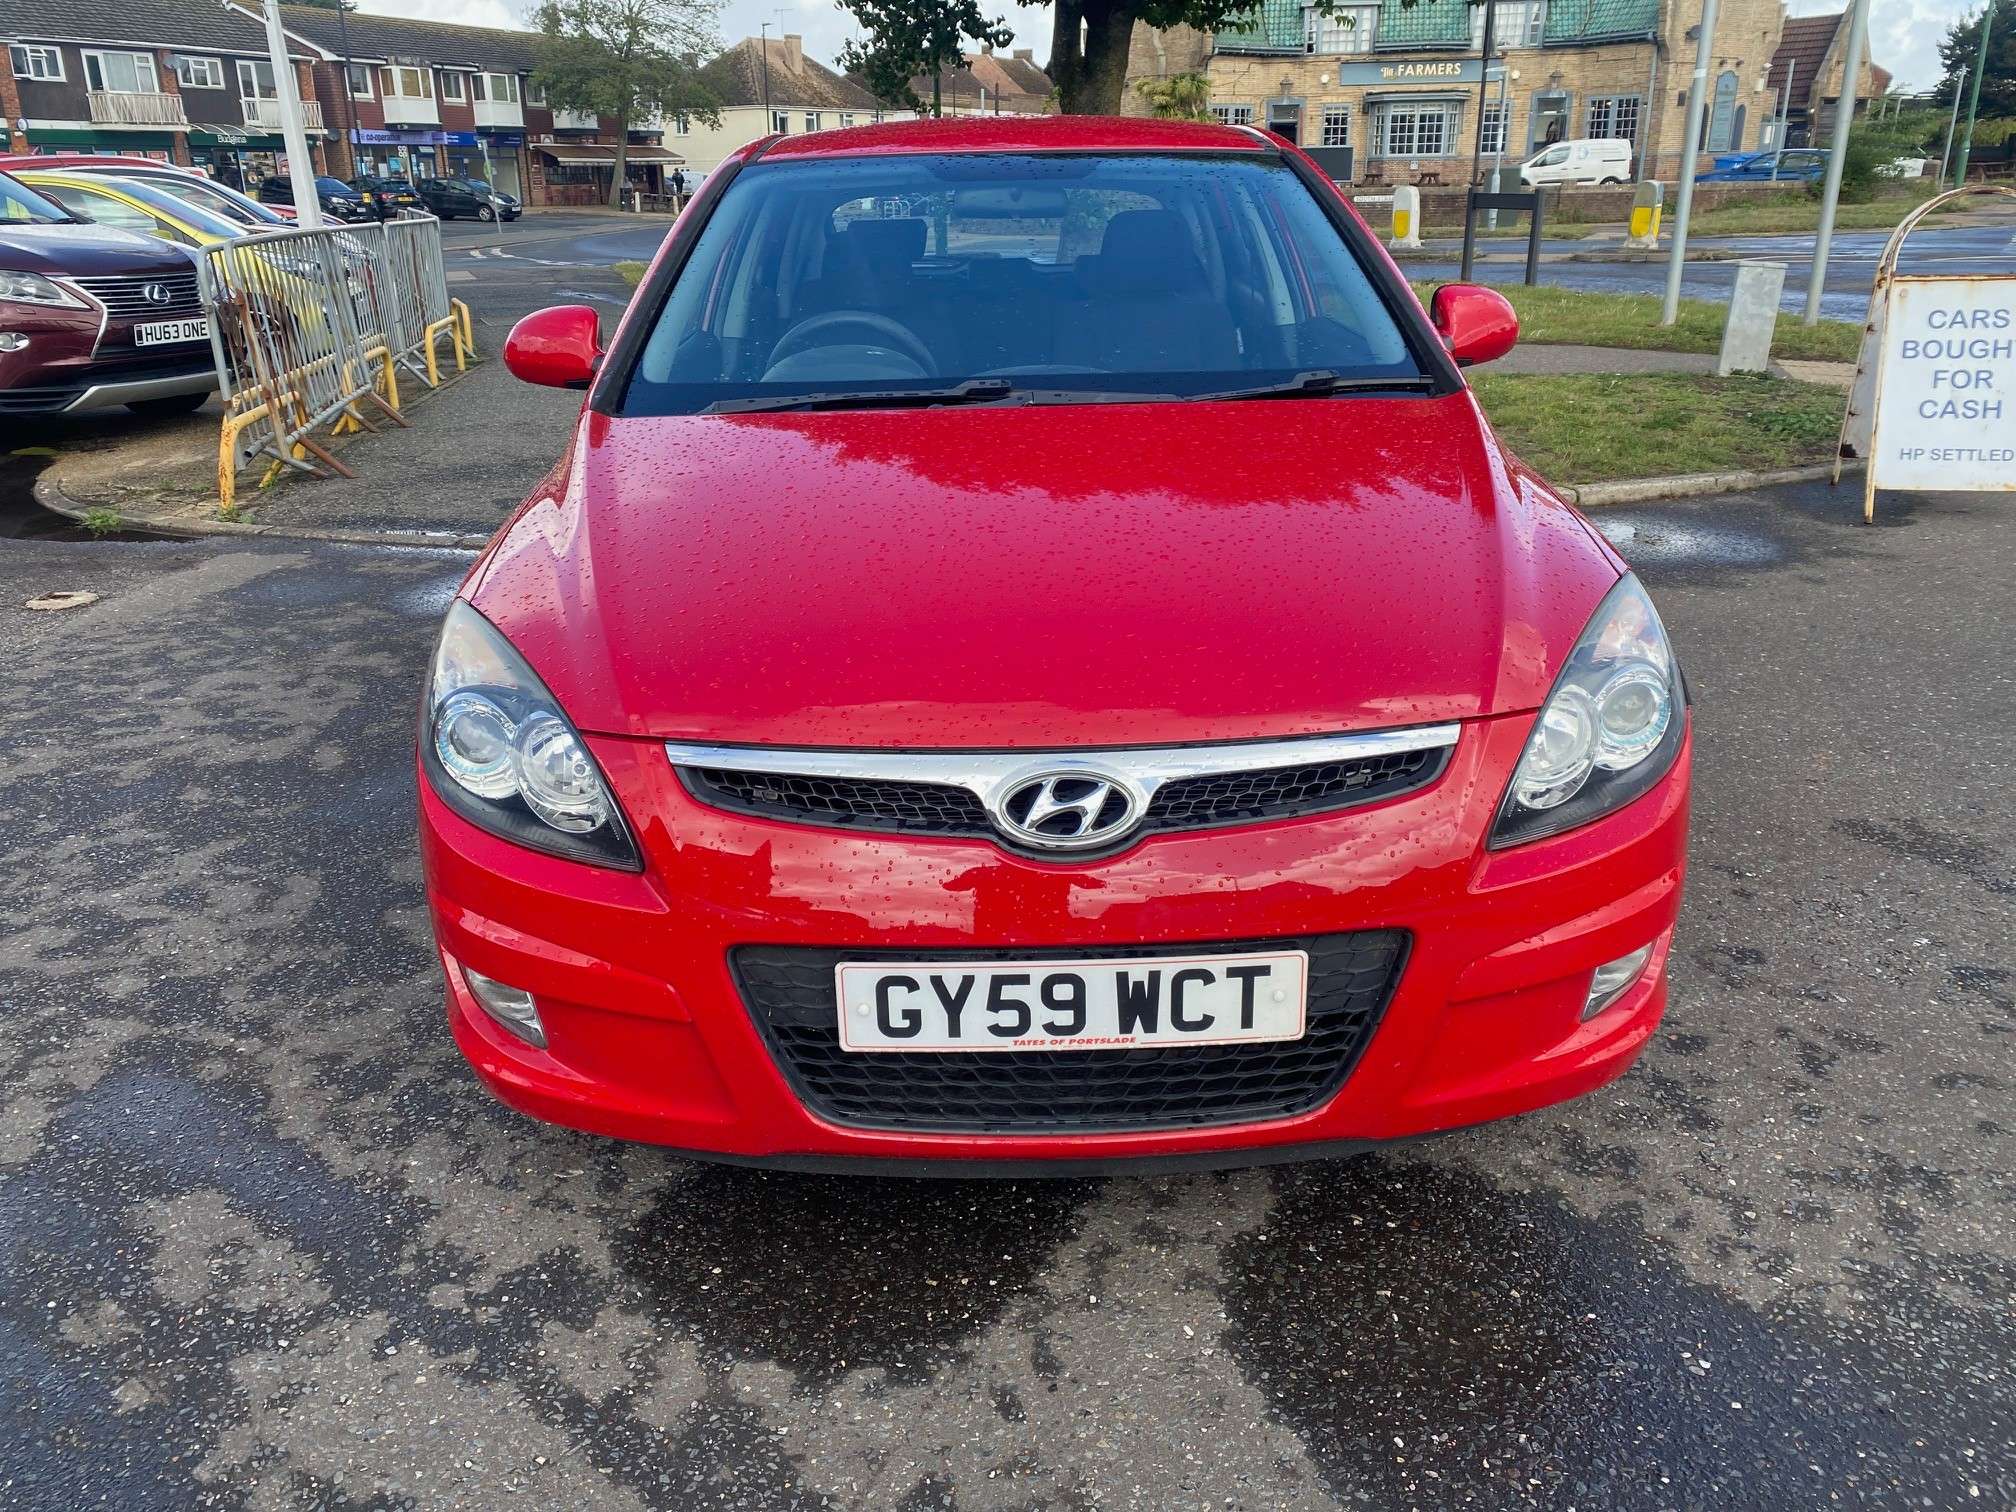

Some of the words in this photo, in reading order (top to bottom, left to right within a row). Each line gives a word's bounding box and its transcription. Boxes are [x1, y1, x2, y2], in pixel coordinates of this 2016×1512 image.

[1398, 63, 1461, 76] FARMERS
[1928, 309, 2011, 330] CARS
[145, 324, 180, 342] HU63
[183, 321, 208, 338] ONE
[1902, 339, 2016, 360] BOUGH
[1933, 369, 1994, 390] FOR
[1919, 399, 2002, 420] CASH
[1899, 448, 1925, 461] HP
[1930, 448, 2015, 462] SETTLED
[875, 972, 1087, 1039] GY59
[1115, 964, 1272, 1034] WCT
[1069, 1036, 1137, 1045] PORTSLADE
